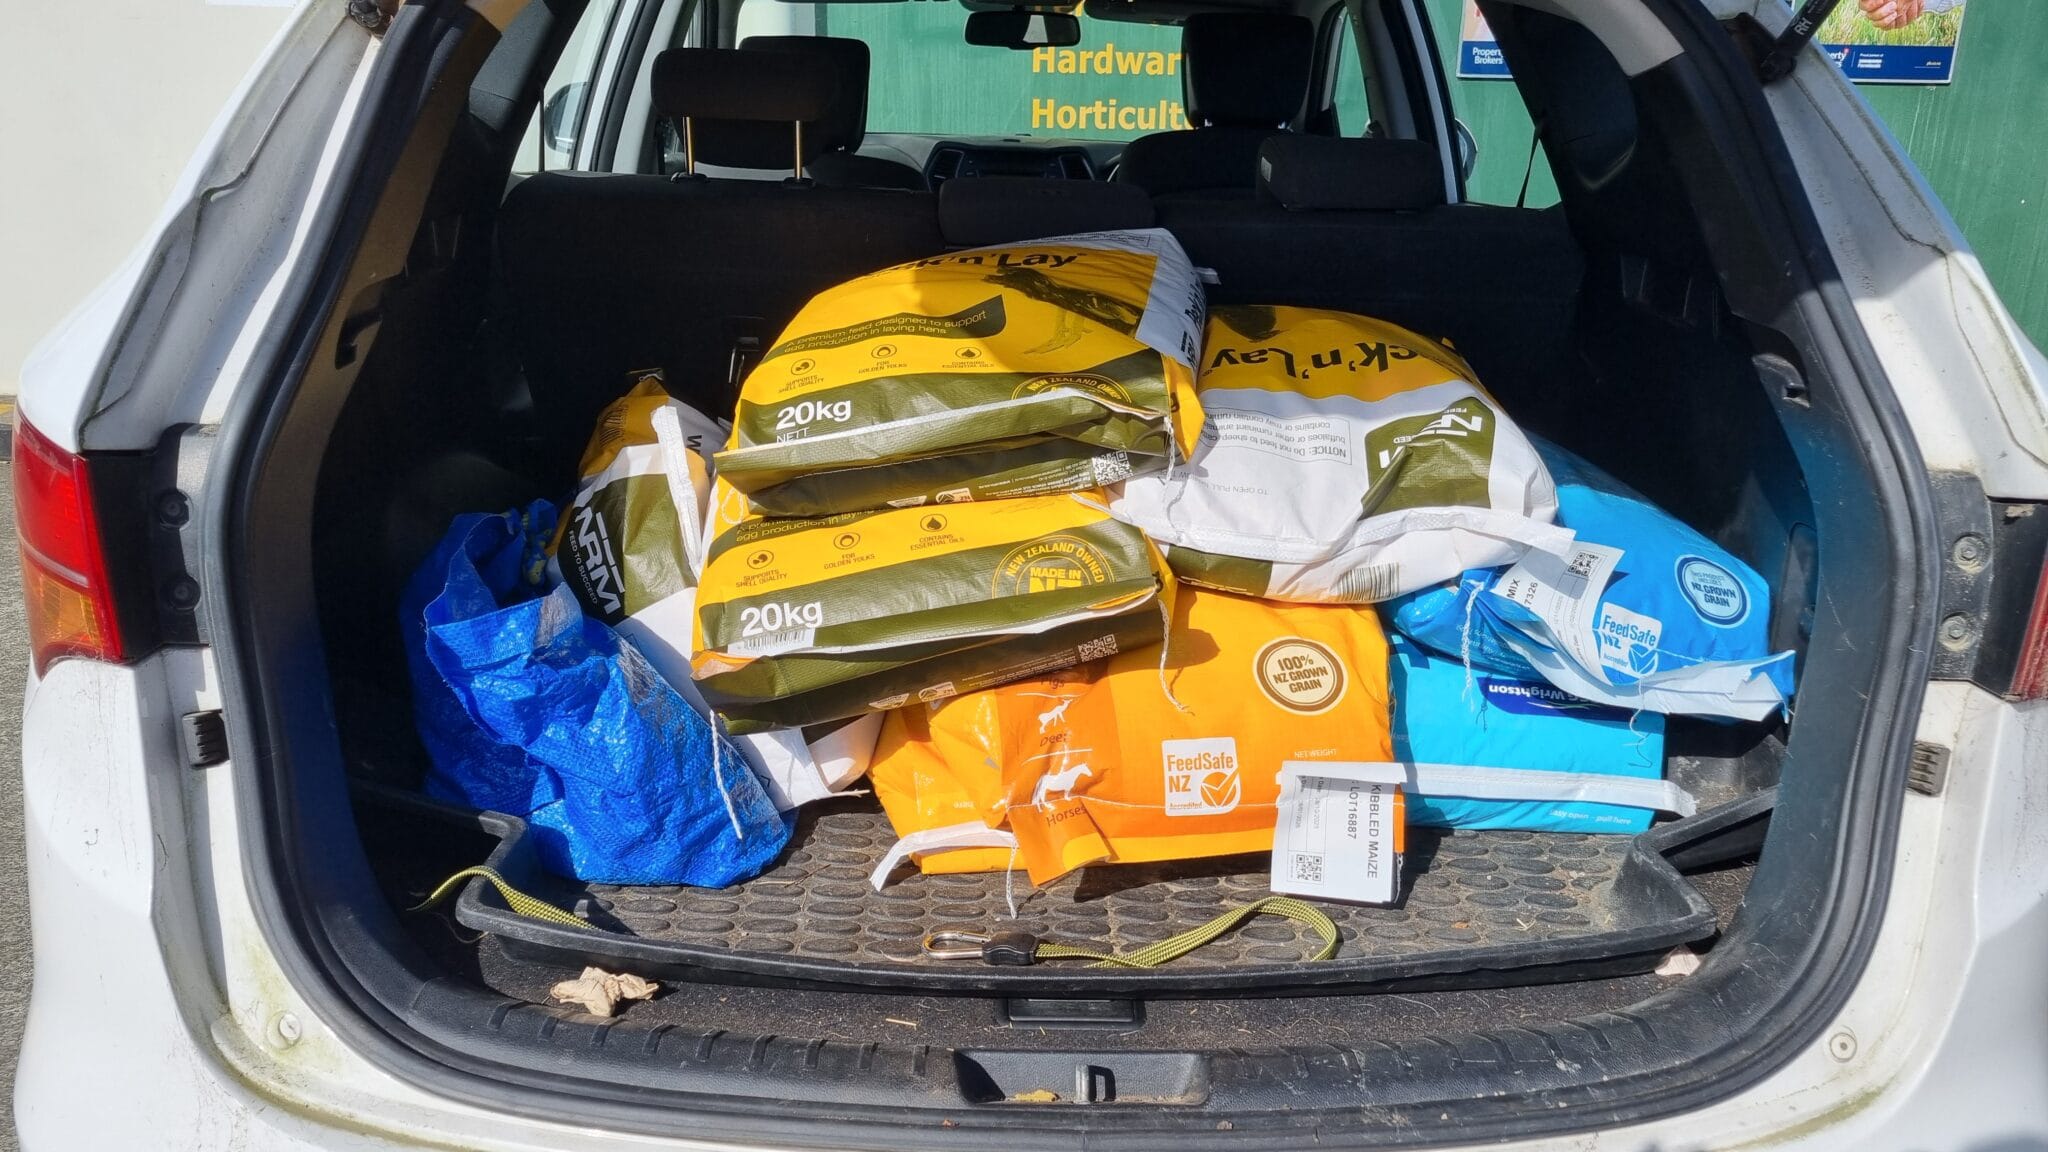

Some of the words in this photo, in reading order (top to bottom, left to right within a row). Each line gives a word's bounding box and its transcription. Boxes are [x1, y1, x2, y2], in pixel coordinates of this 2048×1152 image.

[1032, 43, 1182, 76] Hardwar
[1032, 98, 1192, 130] Horticult
[797, 331, 846, 344] premium
[849, 323, 873, 334] feed
[875, 316, 927, 329] designed
[944, 309, 987, 328] support
[807, 332, 867, 350] production
[882, 322, 916, 335] laying
[918, 324, 947, 334] hens
[1210, 341, 1419, 379] ck'n'Lay
[1050, 377, 1098, 387] ZEALAND
[1097, 383, 1122, 400] OWNE
[776, 400, 852, 430] 20kg
[776, 426, 810, 443] NETT
[1236, 423, 1273, 436] ruminant
[1295, 421, 1331, 432] contains
[1275, 432, 1295, 444] other
[1279, 443, 1293, 454] not
[1308, 433, 1346, 444] buffaloes
[1293, 447, 1306, 457] Do
[1308, 446, 1347, 458] NOTICE:
[1233, 486, 1256, 494] OPEN
[736, 529, 759, 542] egg
[762, 520, 826, 537] production
[828, 515, 838, 525] in
[568, 530, 578, 552] FEED
[574, 554, 582, 565] TO
[579, 565, 598, 604] SUCCEED
[575, 506, 621, 615] NRM
[1005, 553, 1026, 577] NEW
[1024, 542, 1075, 558] ZEALAND
[1075, 547, 1105, 583] OWNED
[1030, 567, 1066, 579] MADE
[1068, 569, 1082, 580] IN
[1507, 578, 1520, 599] MIX
[1524, 582, 1538, 606] 7326
[1703, 584, 1736, 599] GROWN
[1704, 594, 1731, 608] GRAIN
[740, 601, 823, 638] 20kg
[1602, 614, 1656, 647] FeedSafe
[1277, 654, 1314, 671] 100%
[1272, 673, 1289, 684] NZ
[1288, 666, 1329, 681] GROWN
[1289, 679, 1323, 693] GRAIN
[1488, 684, 1565, 700] Wrightson
[1167, 752, 1234, 772] FeedSafe
[1168, 775, 1192, 793] NZ
[1046, 804, 1090, 827] Horses
[1346, 785, 1360, 840] LOT16887
[1368, 784, 1382, 838] KIBBLED
[1367, 840, 1379, 879] MAIZE
